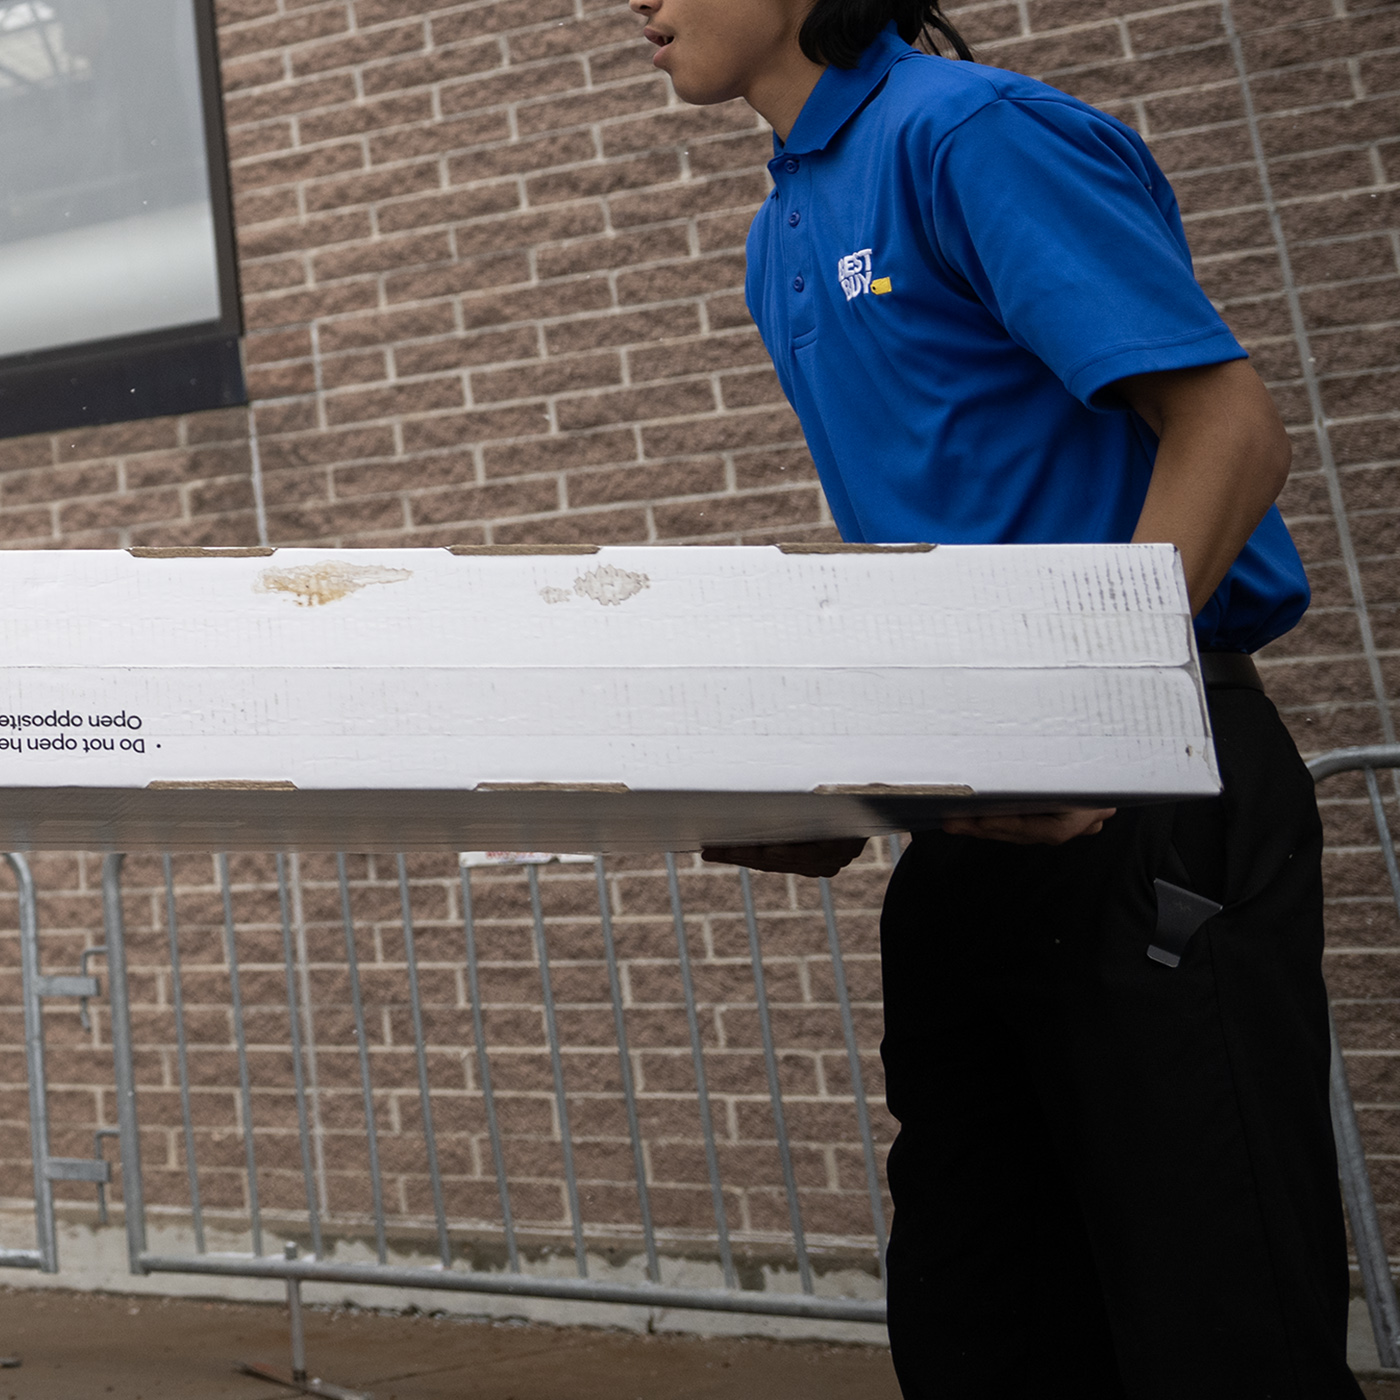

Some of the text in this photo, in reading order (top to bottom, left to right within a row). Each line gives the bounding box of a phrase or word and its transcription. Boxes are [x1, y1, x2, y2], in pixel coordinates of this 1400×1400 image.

[838, 248, 872, 282] BEST
[841, 271, 872, 301] BUY
[88, 710, 142, 730] Open
[26, 733, 77, 750] open
[82, 738, 114, 753] not
[119, 738, 145, 753] Do
